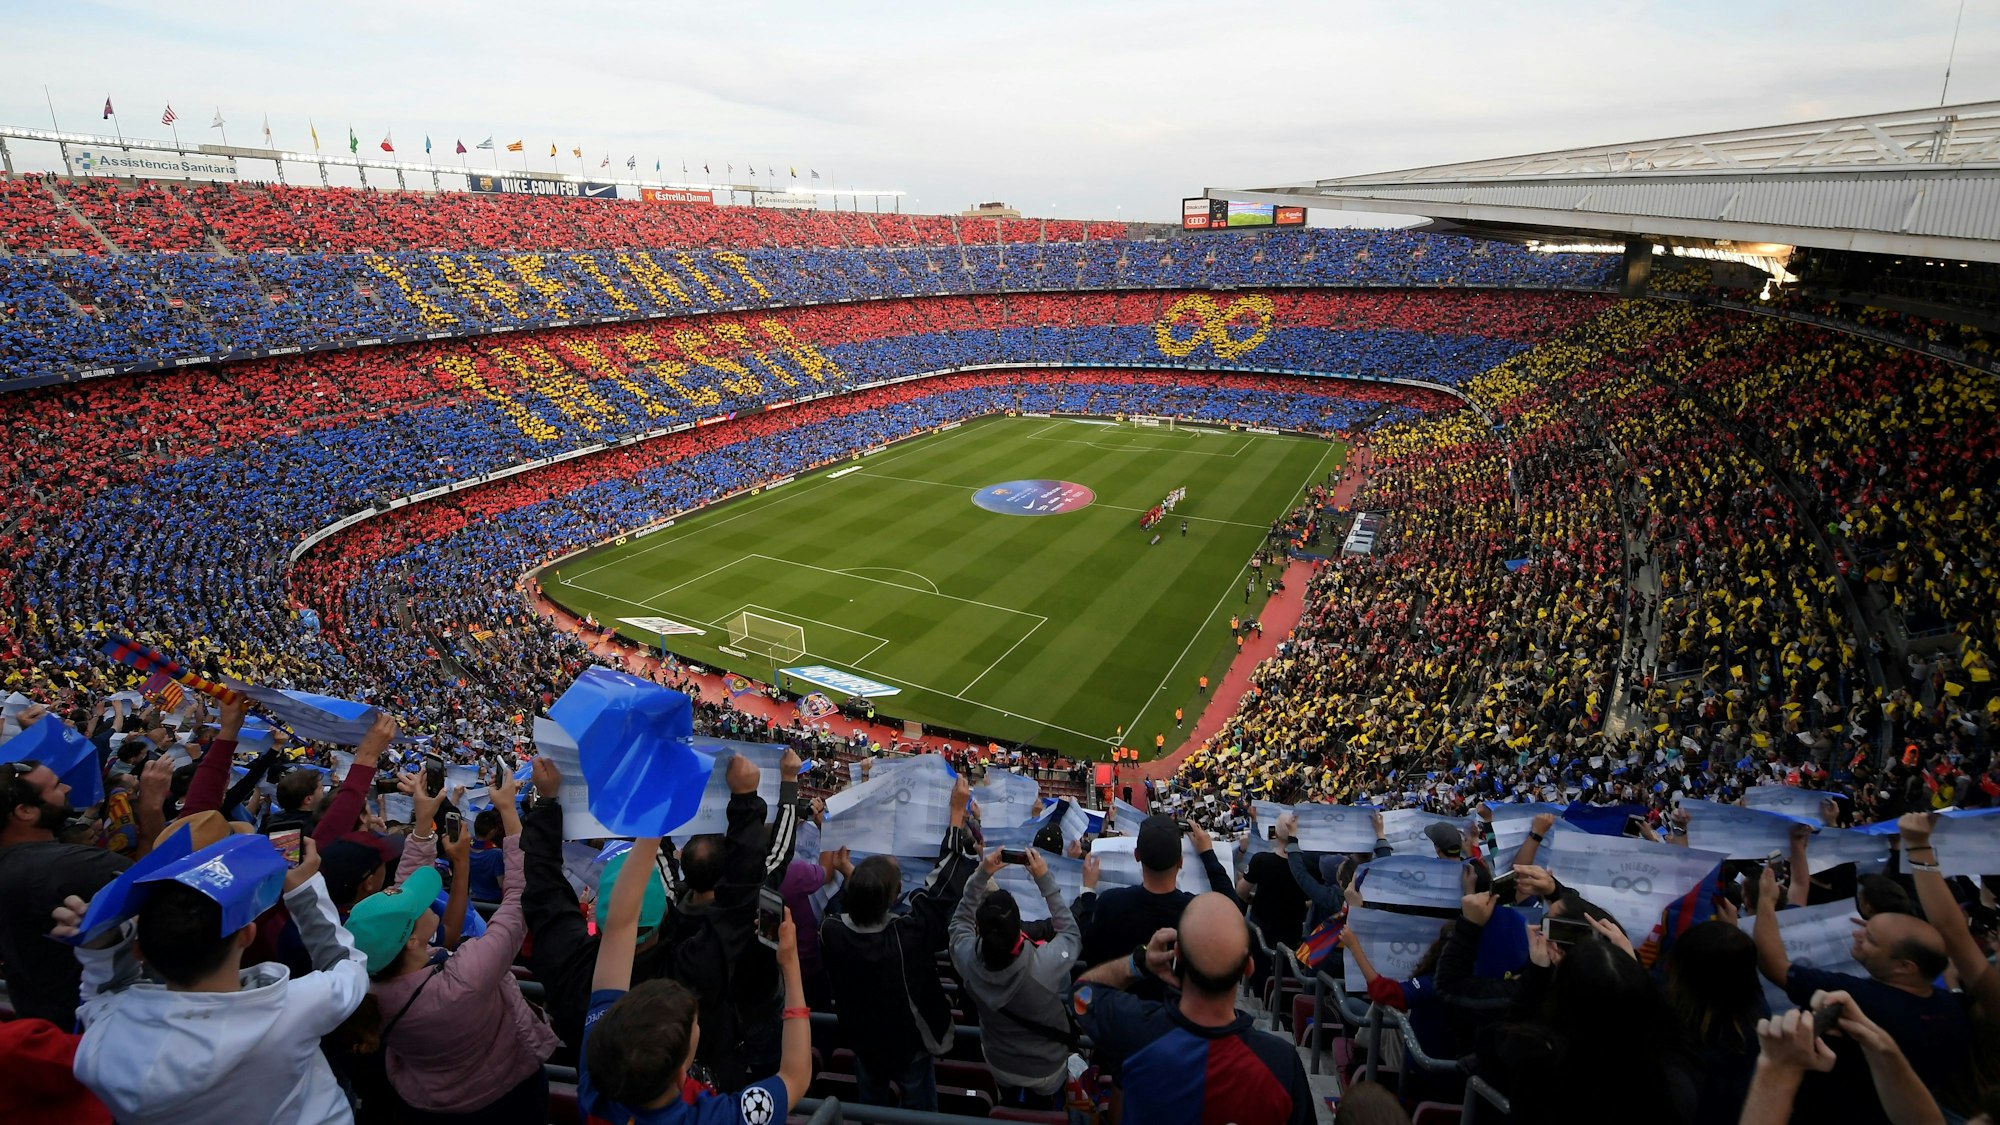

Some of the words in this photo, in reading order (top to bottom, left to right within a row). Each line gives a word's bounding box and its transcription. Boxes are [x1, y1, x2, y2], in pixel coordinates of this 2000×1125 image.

[100, 155, 180, 171] Assistència
[181, 161, 237, 175] Sanitària
[501, 179, 580, 196] NIKE.COM/FCB
[655, 191, 686, 202] Estrella
[686, 192, 711, 203] Damm
[175, 355, 211, 366] NIKE.COM/FCB
[80, 367, 115, 379] NIKE.COM/FCB
[459, 479, 478, 487] Rakuten
[421, 490, 441, 498] Rakuten
[346, 514, 362, 524] Rakuten
[1621, 862, 1660, 878] INIESTA
